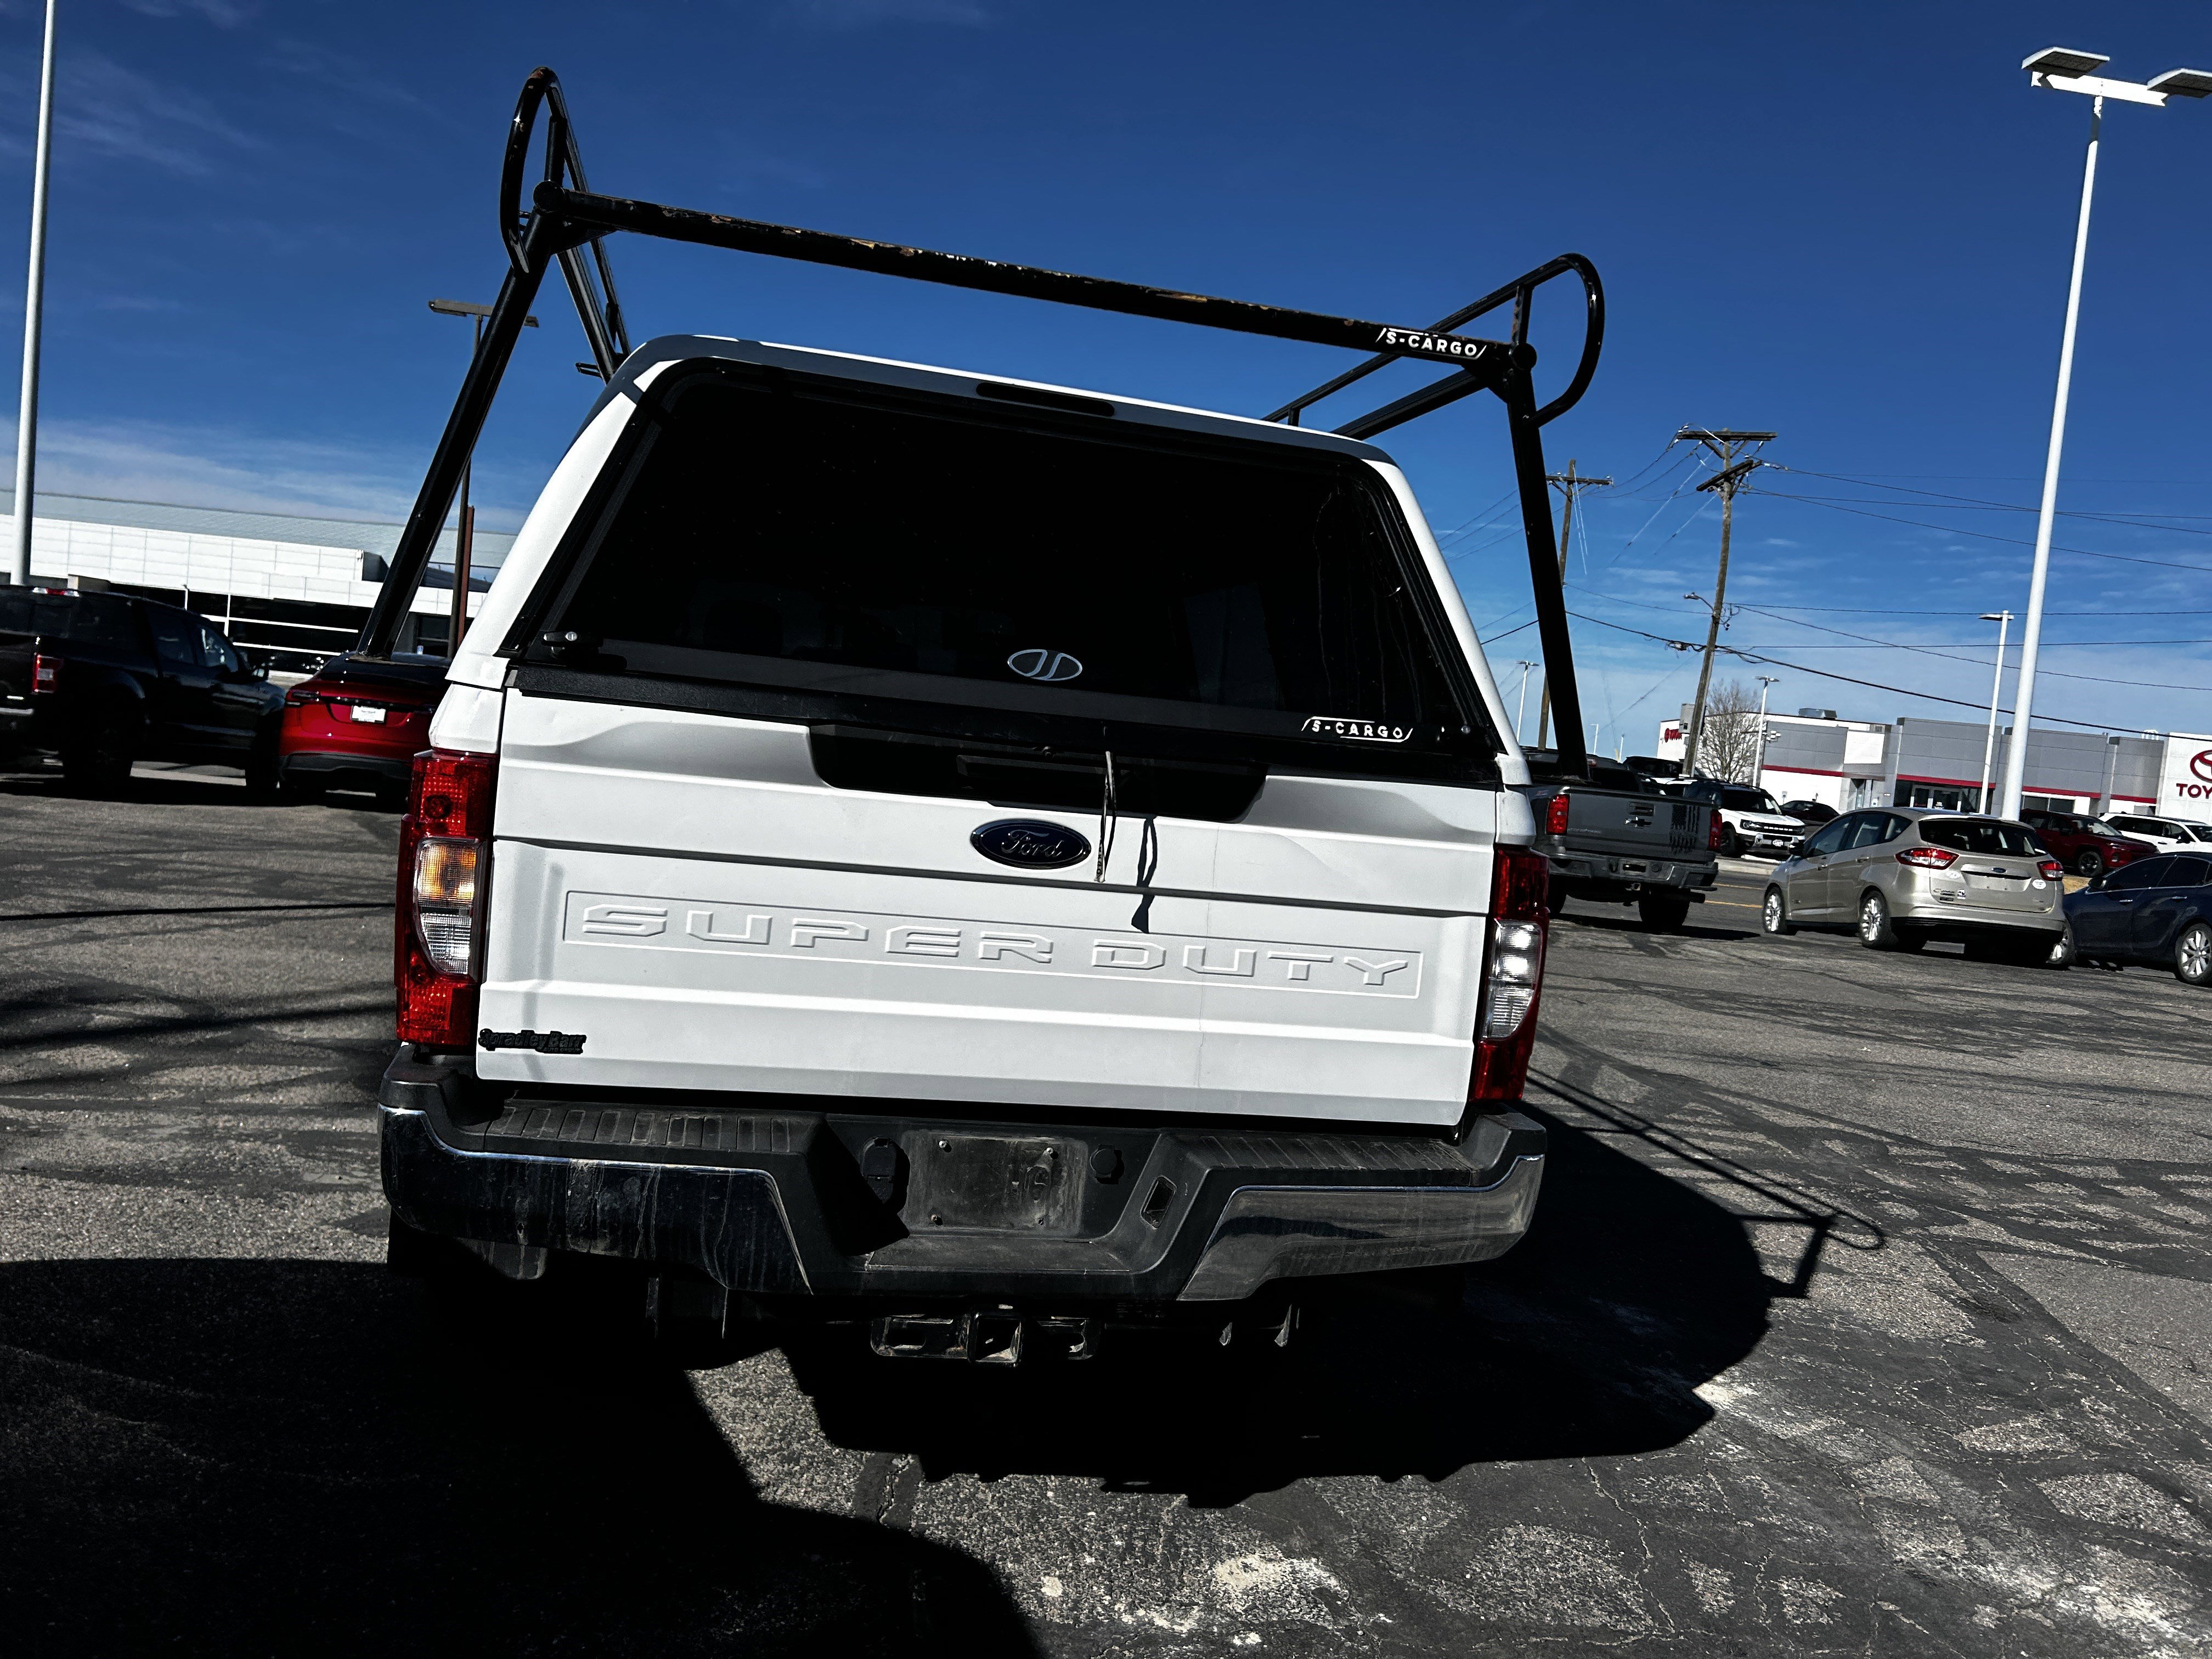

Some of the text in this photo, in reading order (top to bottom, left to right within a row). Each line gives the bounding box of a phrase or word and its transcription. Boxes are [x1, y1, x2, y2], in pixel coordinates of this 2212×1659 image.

[1386, 331, 1477, 357] S-CARGO
[1311, 719, 1403, 739] S-CARGO
[1001, 829, 1064, 858] Ford
[582, 903, 1408, 986] SUPER DUTY
[479, 1030, 584, 1051] Spradley Barr
